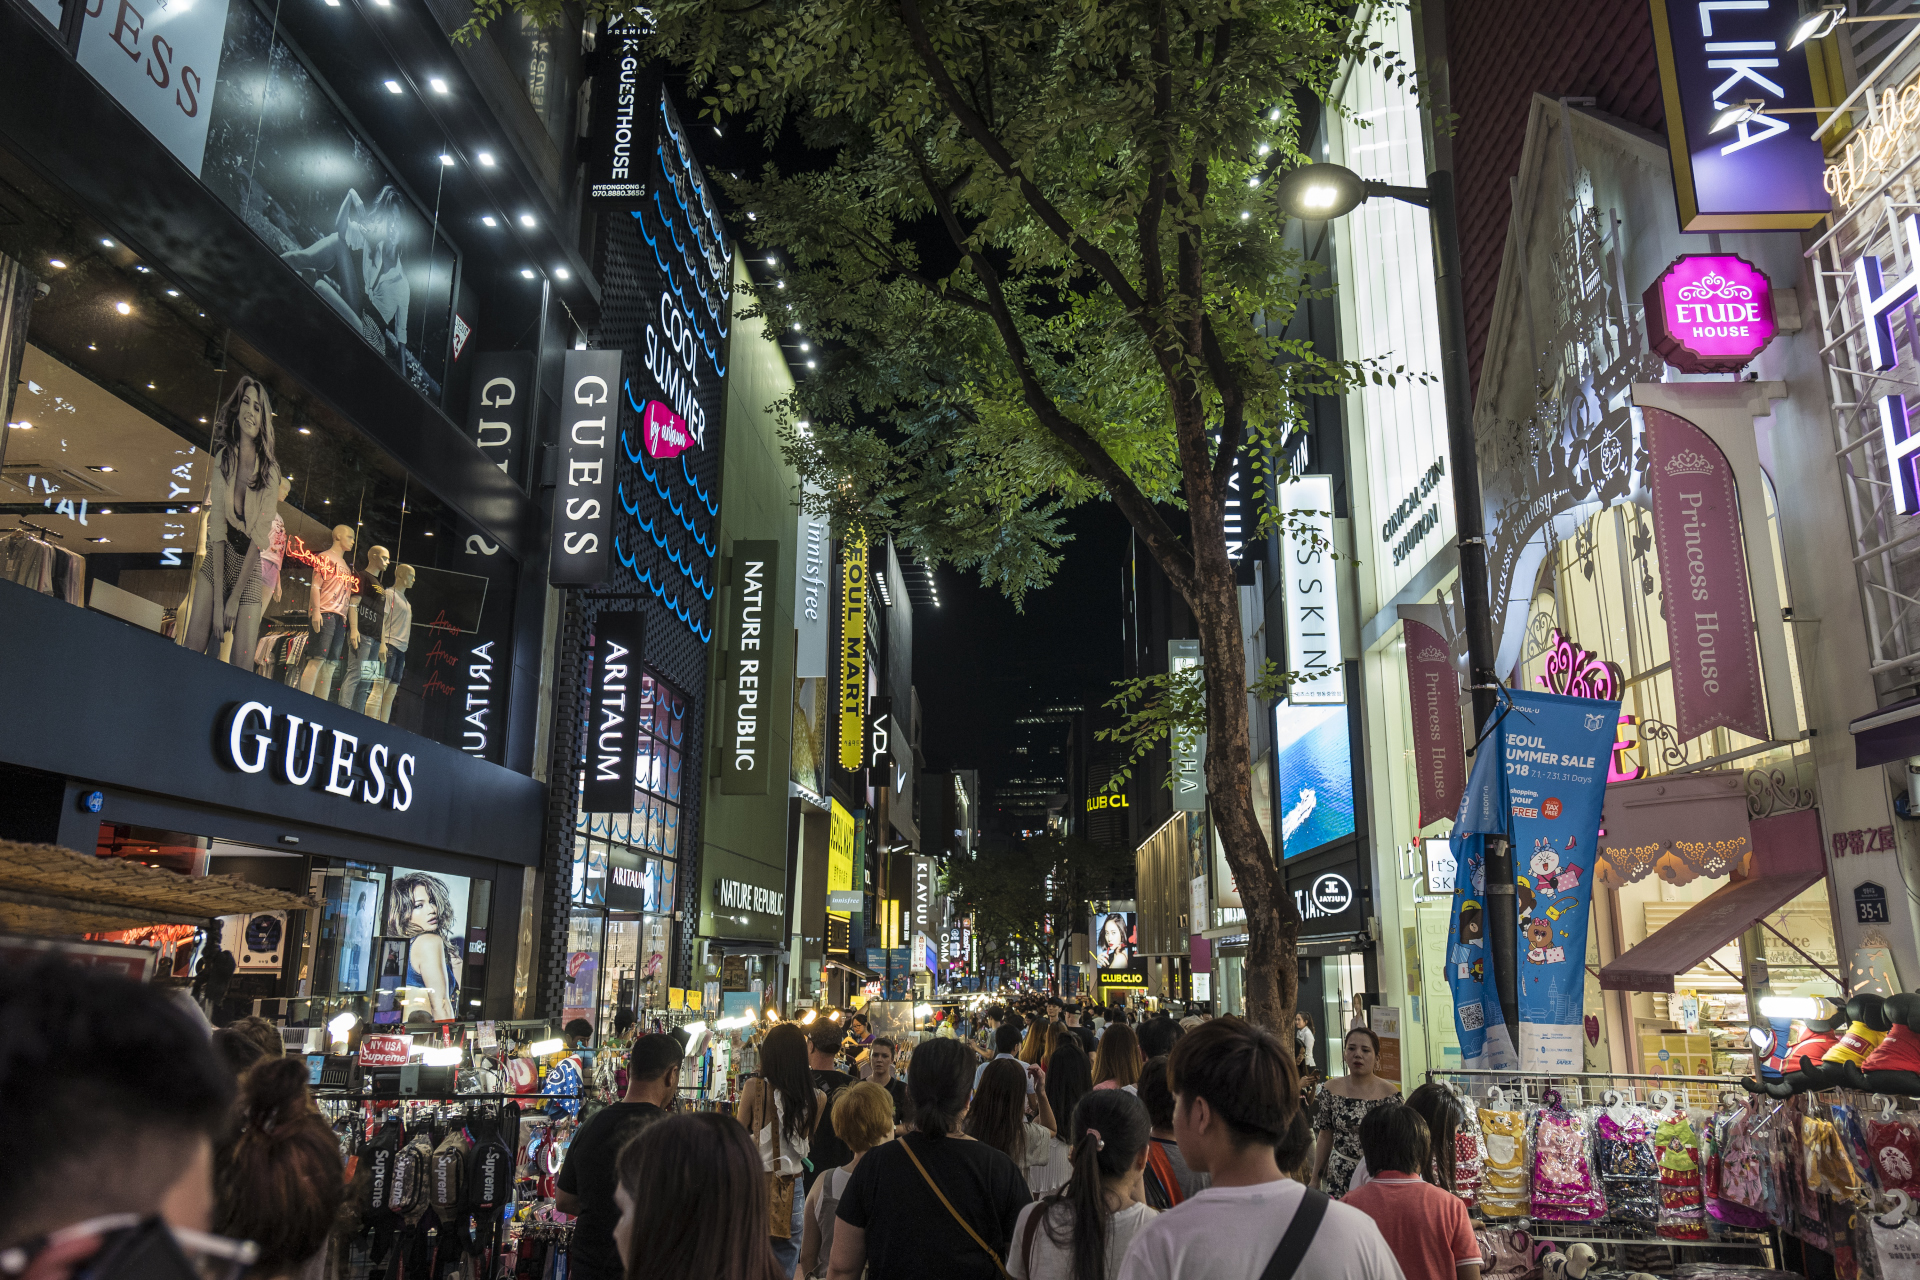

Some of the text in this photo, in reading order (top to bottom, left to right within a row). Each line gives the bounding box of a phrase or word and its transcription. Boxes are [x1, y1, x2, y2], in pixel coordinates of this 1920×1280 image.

[1676, 302, 1761, 324] ETUDE
[1692, 325, 1750, 338] HOUSE
[661, 292, 699, 387] COOL
[644, 324, 705, 451] SUMMER
[563, 375, 608, 555] GUESS
[1420, 456, 1445, 498] SKIN
[802, 521, 826, 621] innisfree
[1679, 491, 1720, 697] Princess House
[845, 547, 863, 718] EOUL MART
[735, 561, 764, 771] NATURE REPUBLIC
[596, 640, 629, 782] ARITAUM
[1425, 672, 1447, 799] Princess House
[230, 700, 416, 812] GUESS
[873, 714, 888, 767] VDL
[1506, 732, 1546, 750] EOUL
[1506, 747, 1596, 769] UMMER SALE
[1511, 796, 1533, 805] your
[1571, 774, 1592, 785] Days
[1511, 806, 1538, 818] FREE
[1545, 803, 1559, 811] TAX
[612, 866, 647, 890] ARITAUM
[720, 878, 784, 916] NATURE REPUBLIC
[916, 862, 928, 925] KLAVUU
[1860, 903, 1883, 919] 35-1
[361, 1050, 407, 1063] Supreme
[385, 1041, 402, 1051] USA
[371, 1150, 390, 1208] Supreme
[434, 1155, 452, 1204] Supreme
[482, 1152, 500, 1201] Supreme
